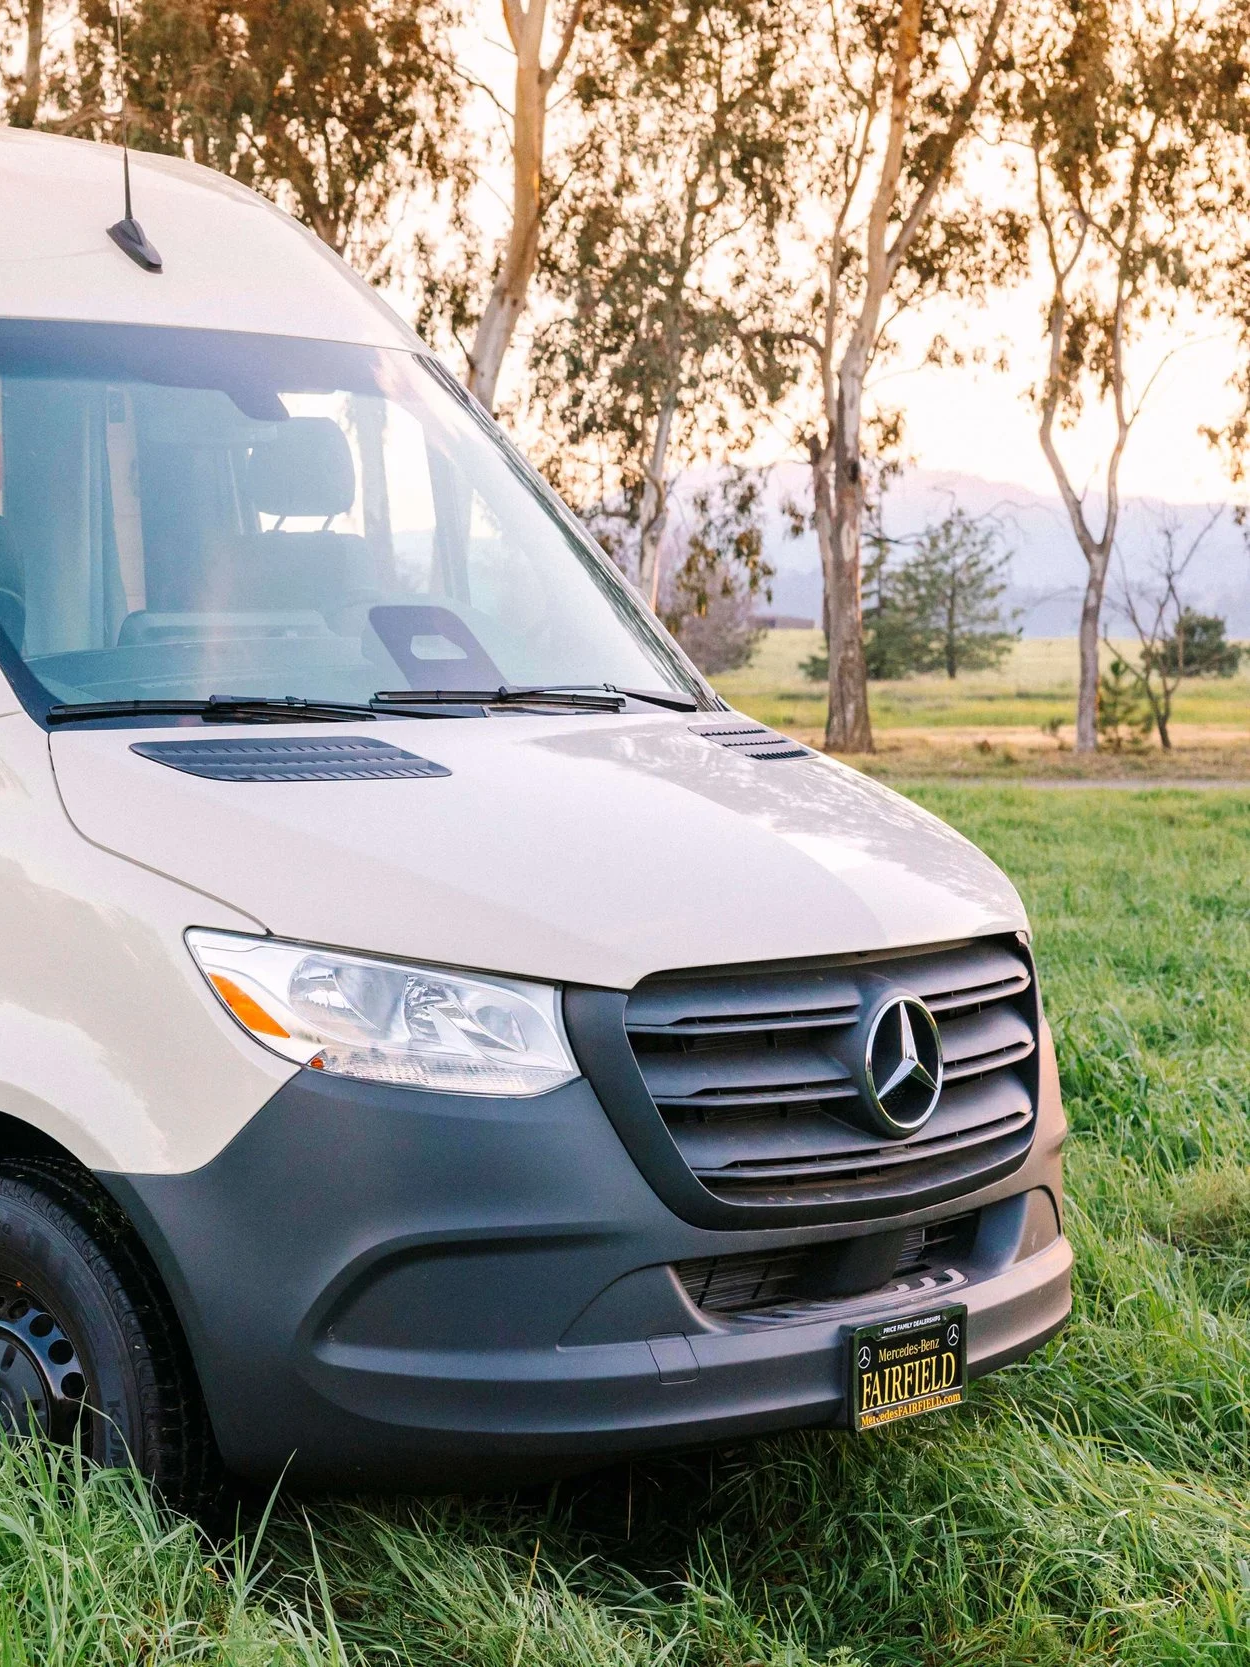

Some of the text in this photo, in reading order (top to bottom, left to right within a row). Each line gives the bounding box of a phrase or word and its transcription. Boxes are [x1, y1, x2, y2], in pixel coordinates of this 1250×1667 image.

[883, 1315, 941, 1334] PRICE FAMILY DEALERSHIPS
[878, 1338, 940, 1363] Mercedes-Benz
[861, 1352, 956, 1411] FAIRFIELD
[860, 1393, 961, 1428] MercedesFAIRFIELD.com
